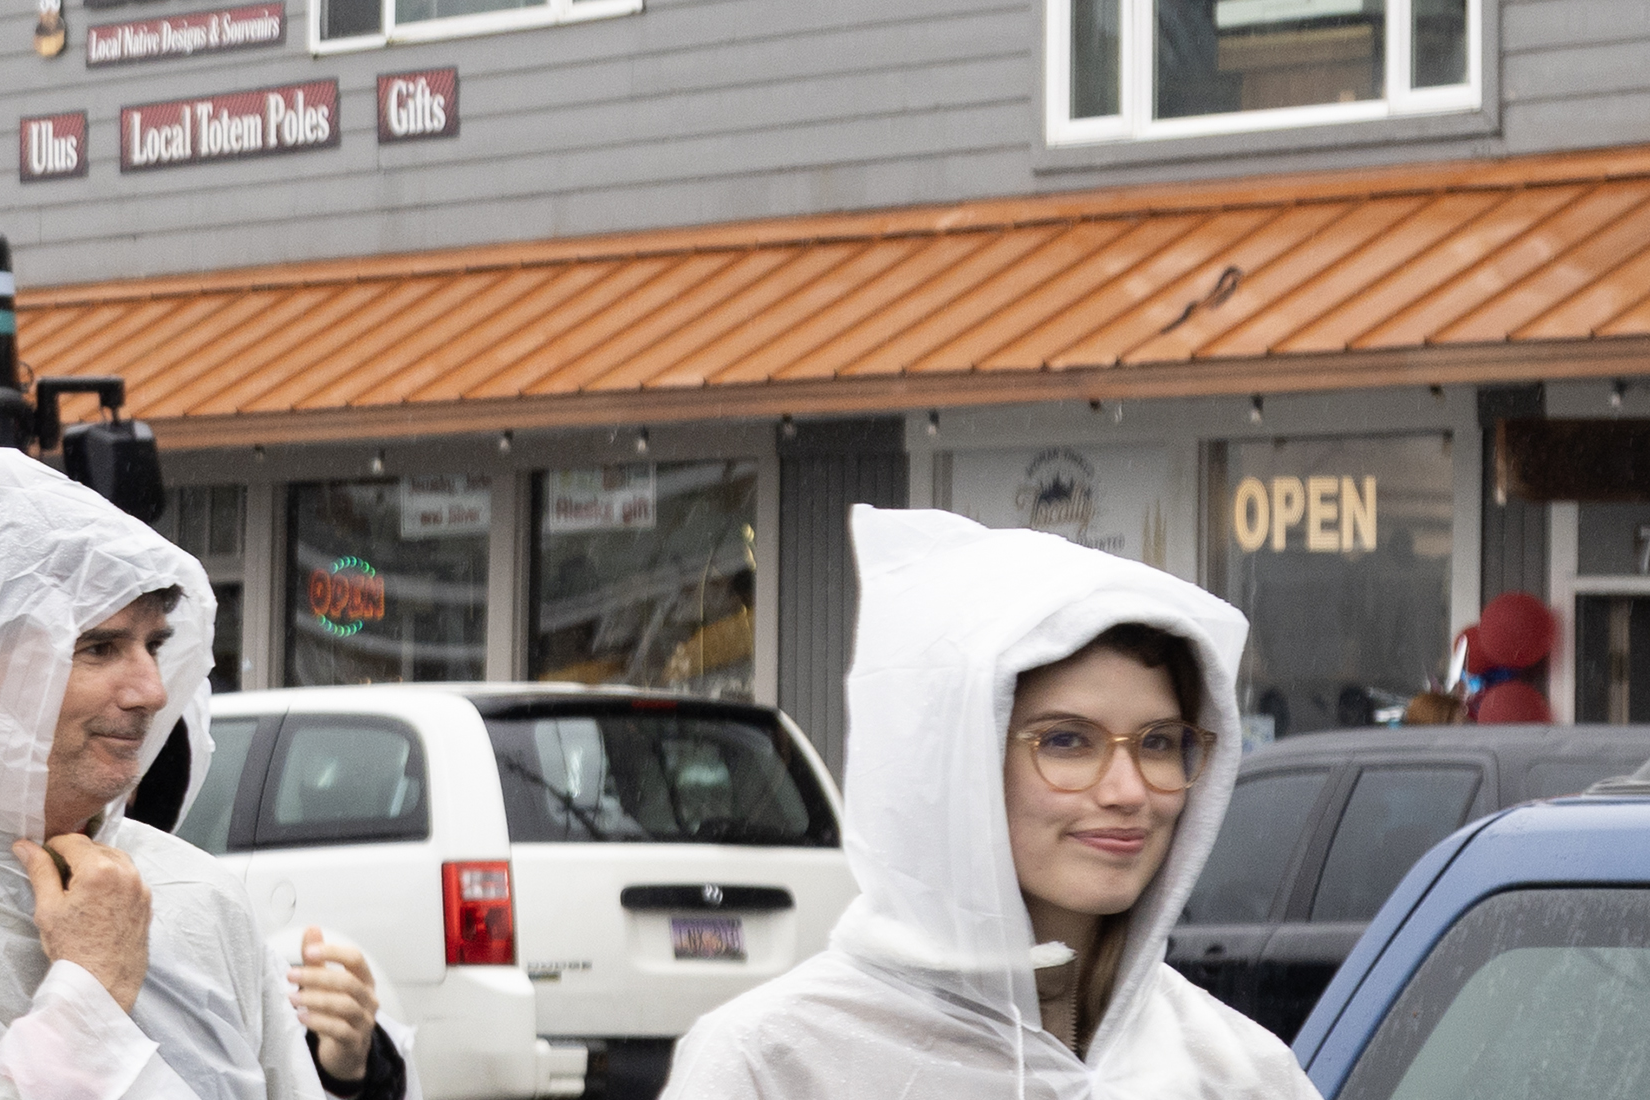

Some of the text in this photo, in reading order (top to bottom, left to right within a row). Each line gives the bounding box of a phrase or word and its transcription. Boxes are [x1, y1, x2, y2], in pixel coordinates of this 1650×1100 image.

[91, 9, 280, 63] Local Native Designs & Souvenirs
[130, 89, 331, 166] Local Totem Poles
[388, 76, 447, 136] Gifts
[29, 119, 78, 175] Ulus
[1234, 475, 1377, 553] OPEN
[309, 569, 385, 619] OPEN
